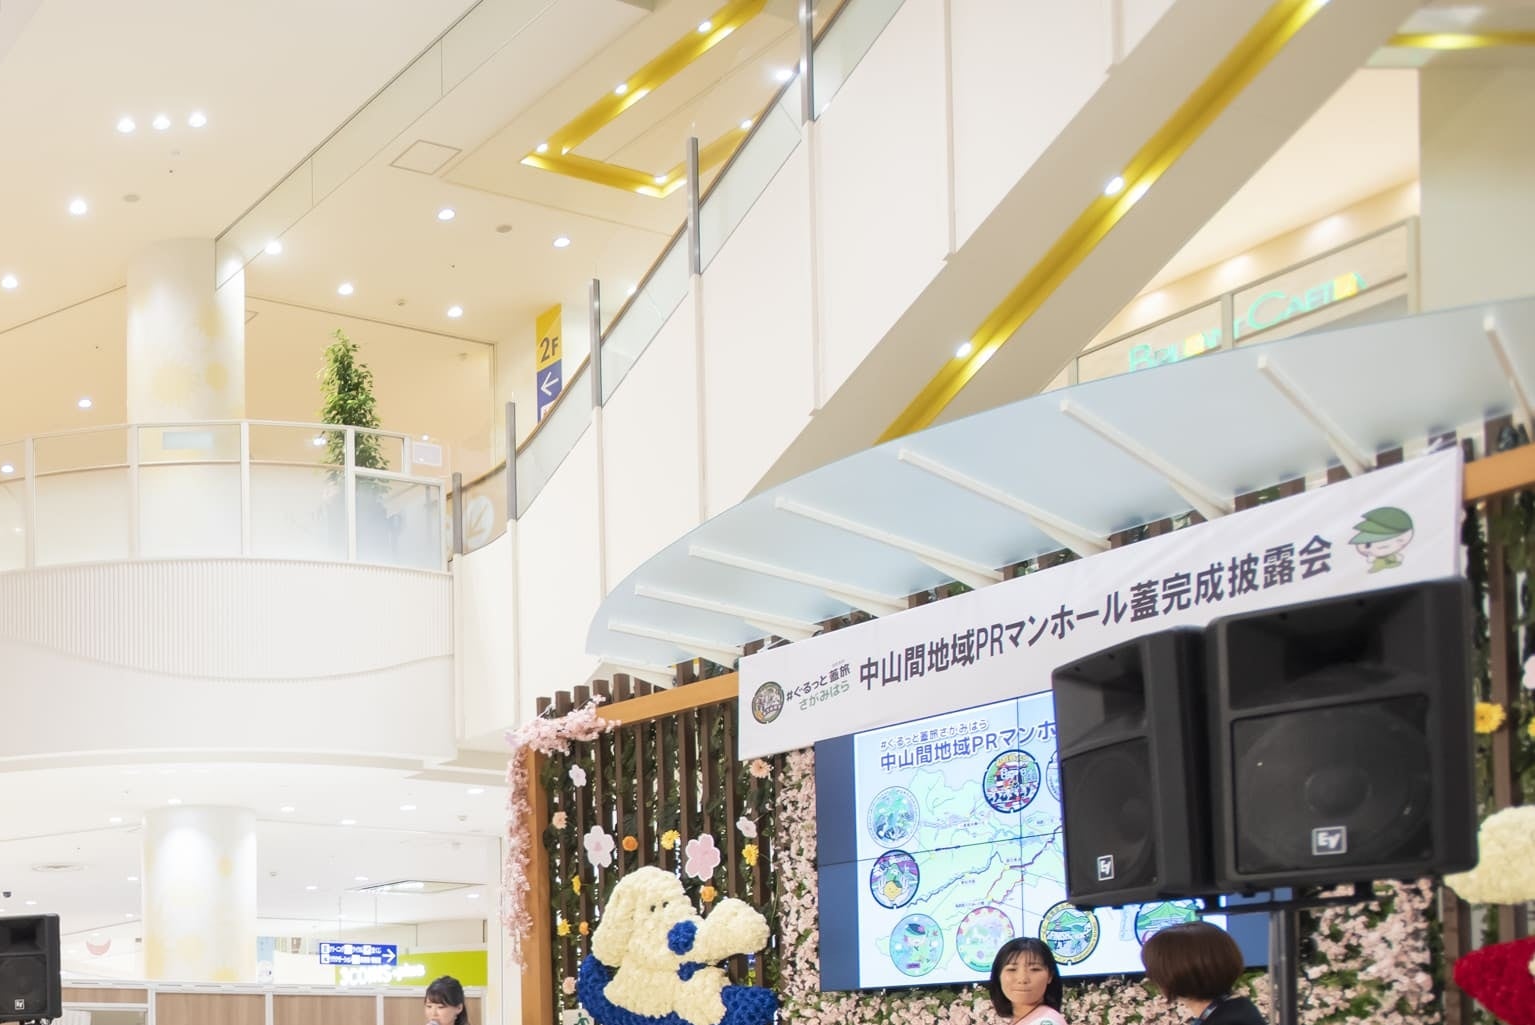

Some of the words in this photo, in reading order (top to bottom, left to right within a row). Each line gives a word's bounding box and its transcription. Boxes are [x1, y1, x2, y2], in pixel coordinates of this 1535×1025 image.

[540, 336, 560, 363] 2F
[859, 534, 1334, 692] 中山間地域PRマンホール蓋完成披露会
[799, 680, 850, 711] さがみはら
